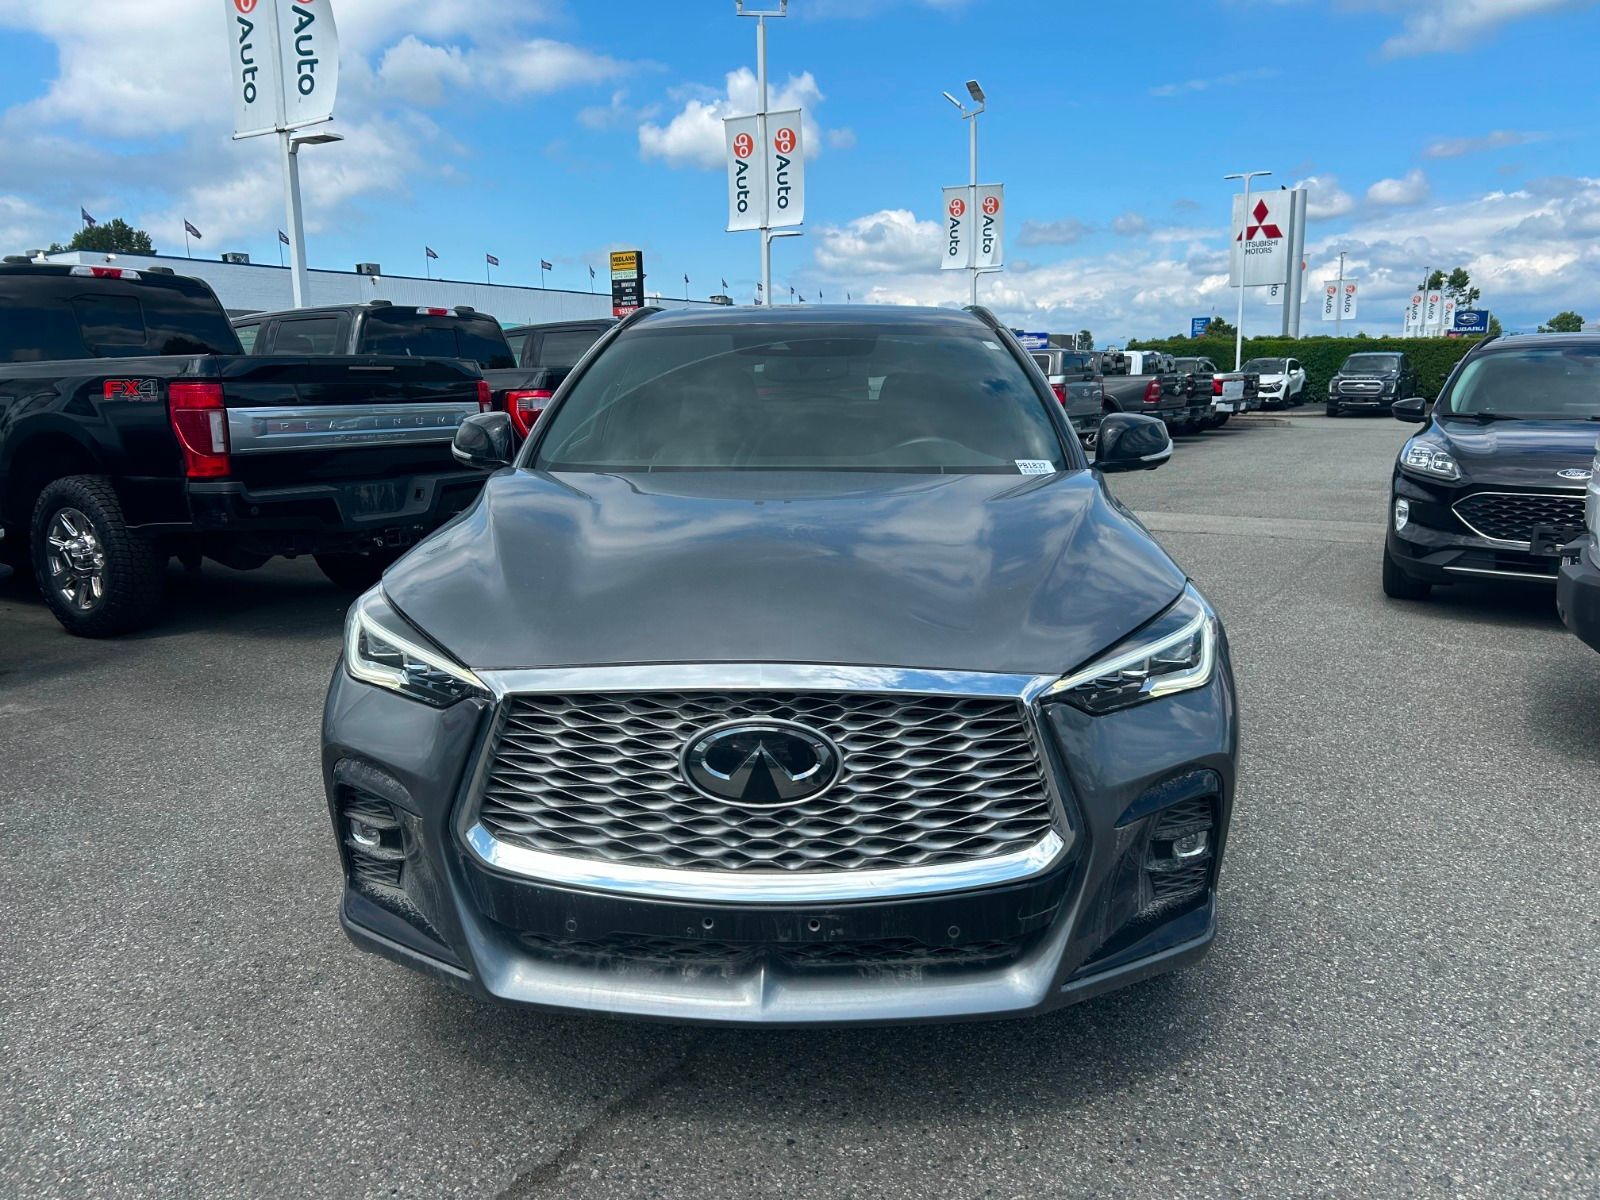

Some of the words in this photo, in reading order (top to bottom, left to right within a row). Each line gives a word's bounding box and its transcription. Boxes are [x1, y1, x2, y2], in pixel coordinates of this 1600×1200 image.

[236, 16, 258, 104] Auto
[292, 5, 318, 95] Auto
[735, 159, 750, 213] Auto
[775, 154, 791, 209] Auto
[949, 217, 961, 256] Auto
[982, 215, 995, 254] Auto
[1240, 240, 1279, 248] ITSUBISHI
[1245, 247, 1273, 255] MOTORS
[1325, 294, 1333, 314] Auto
[1344, 293, 1352, 313] Auto
[103, 379, 158, 400] FX4
[279, 415, 446, 431] PLATINUM
